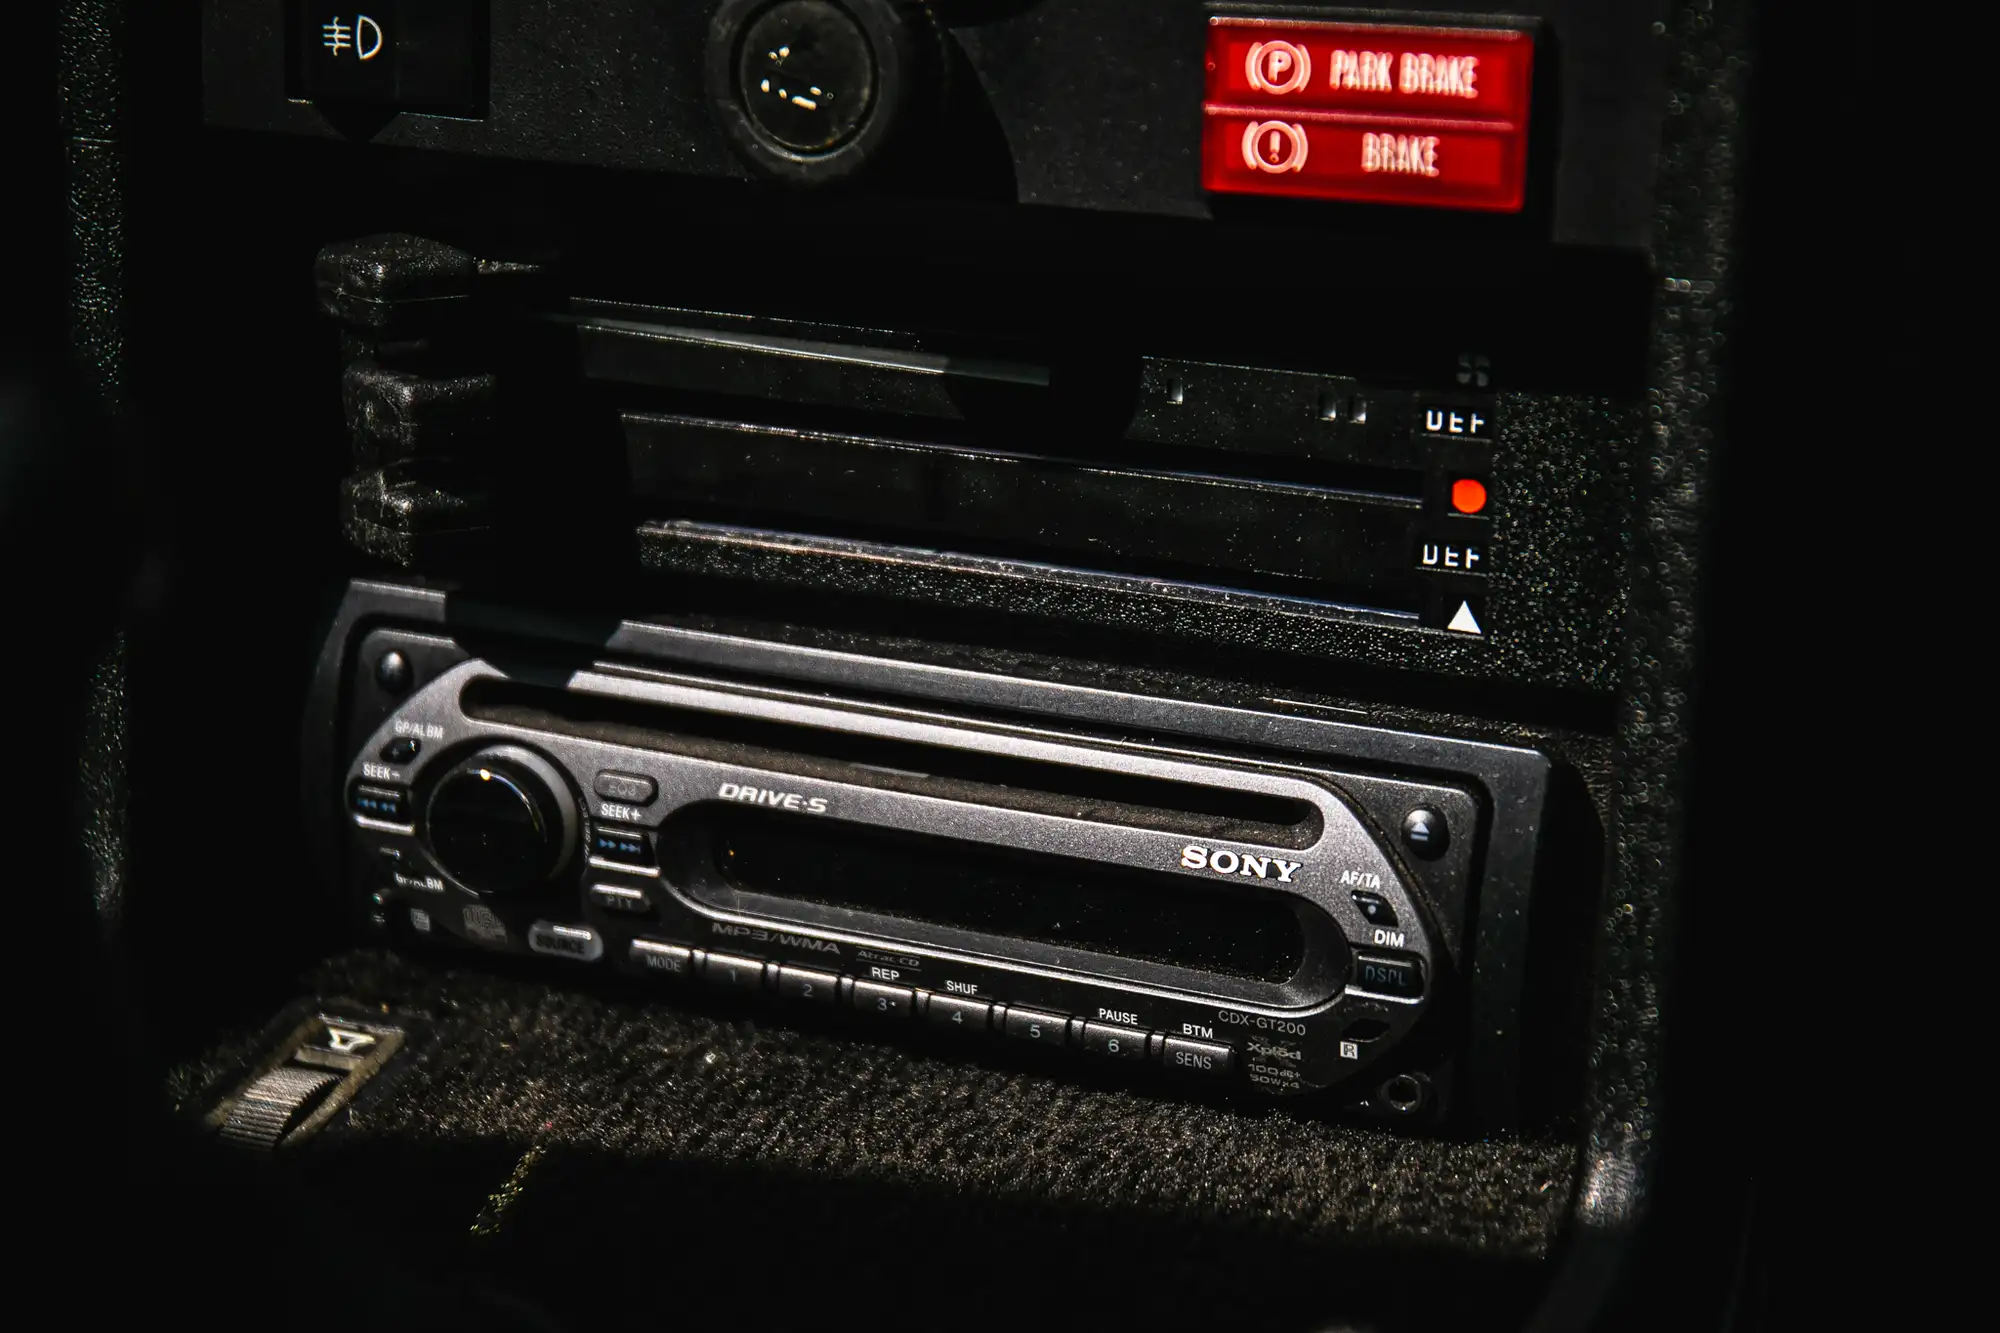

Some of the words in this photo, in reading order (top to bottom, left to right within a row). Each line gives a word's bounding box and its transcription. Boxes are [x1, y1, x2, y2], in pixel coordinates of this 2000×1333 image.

[1329, 49, 1394, 93] PARK
[1398, 52, 1480, 99] BRAKE
[1360, 131, 1441, 178] BRAKE
[394, 720, 444, 741] GP/ALBM
[1180, 845, 1302, 883] SONY
[1340, 869, 1381, 889] AF/TA
[711, 922, 842, 956] MP3/WMA
[1373, 928, 1406, 948] DIM
[646, 955, 682, 973] MODE
[871, 966, 901, 981] REP
[1364, 964, 1409, 987] DSPL
[803, 983, 814, 997] 2
[945, 979, 979, 996] SHUF
[951, 1010, 963, 1025] 4
[1098, 1007, 1139, 1026] PAUSE
[1217, 1009, 1307, 1037] CDX-GT200
[1029, 1023, 1042, 1039] 5
[1182, 1022, 1214, 1039] BTM
[1107, 1038, 1120, 1053] 6
[1175, 1051, 1213, 1070] SENS
